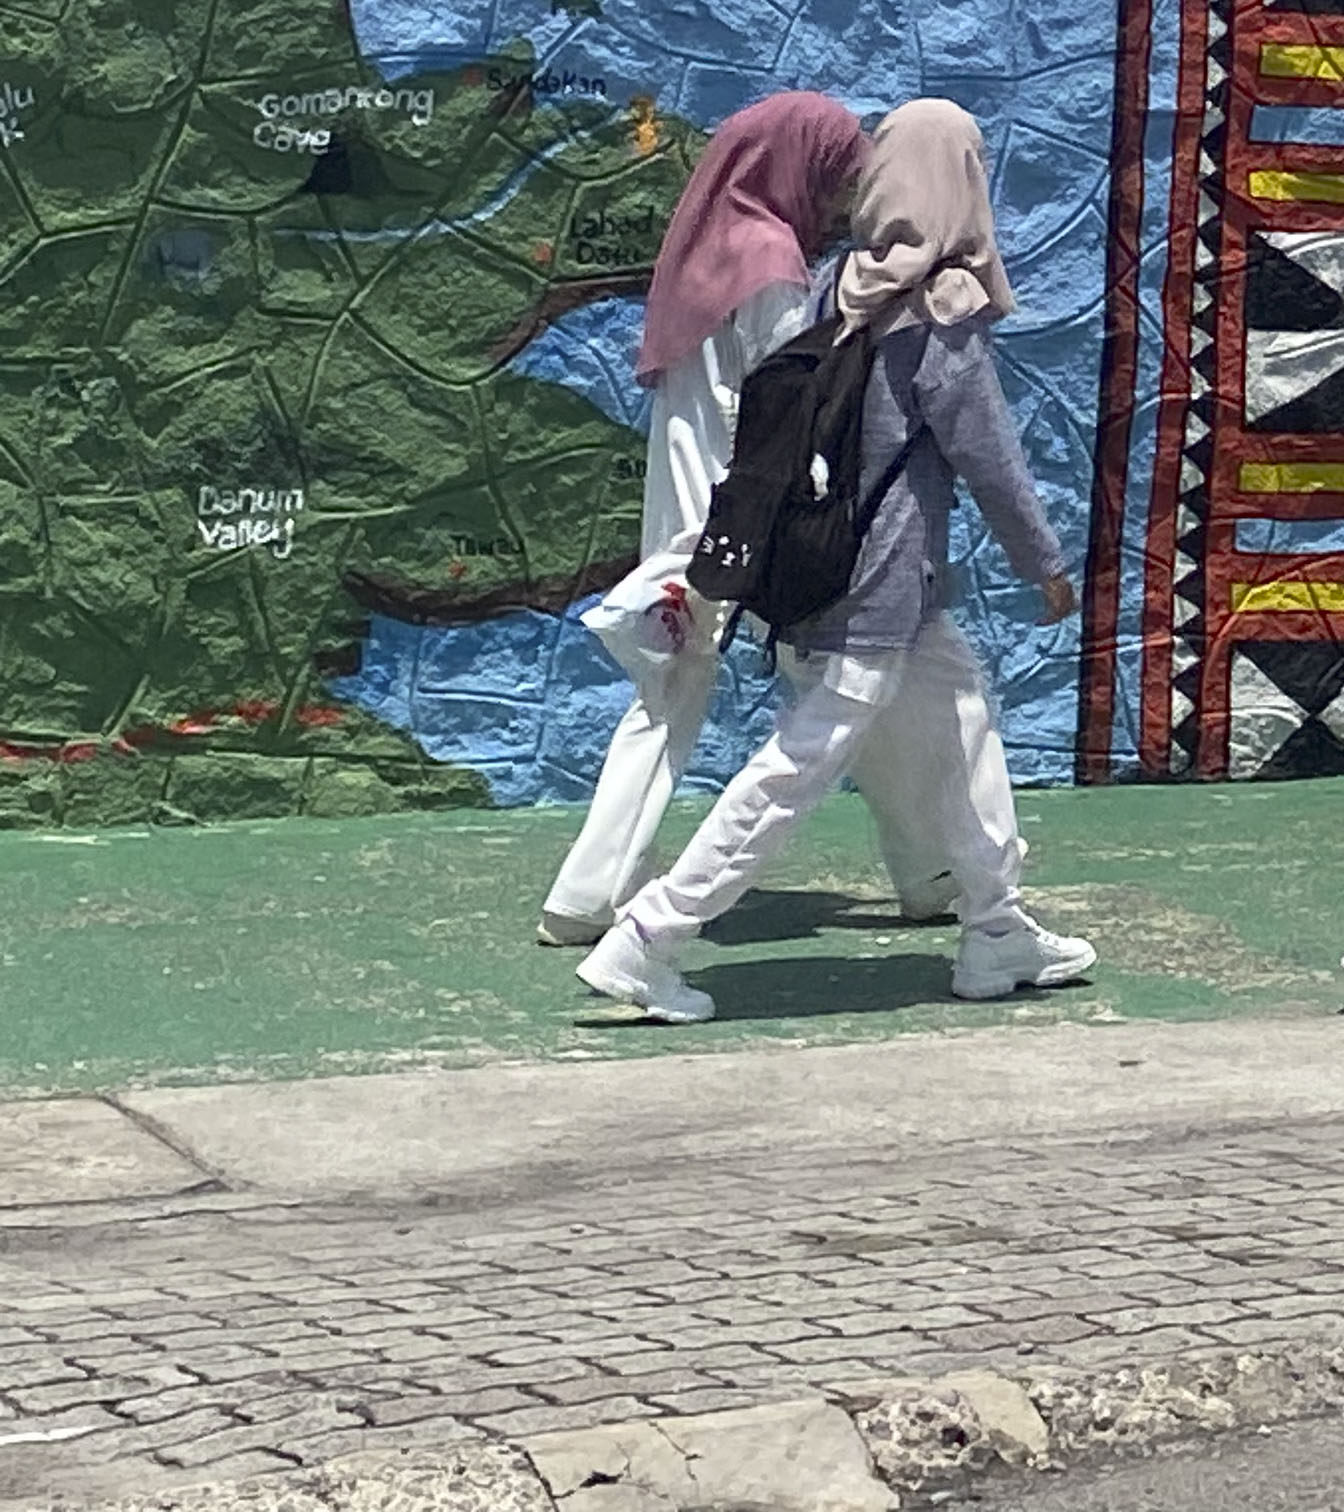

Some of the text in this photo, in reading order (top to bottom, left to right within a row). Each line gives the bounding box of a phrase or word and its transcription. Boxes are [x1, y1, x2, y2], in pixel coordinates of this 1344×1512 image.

[253, 121, 331, 155] Cave
[199, 486, 303, 515] Danum
[198, 517, 294, 559] Valley
